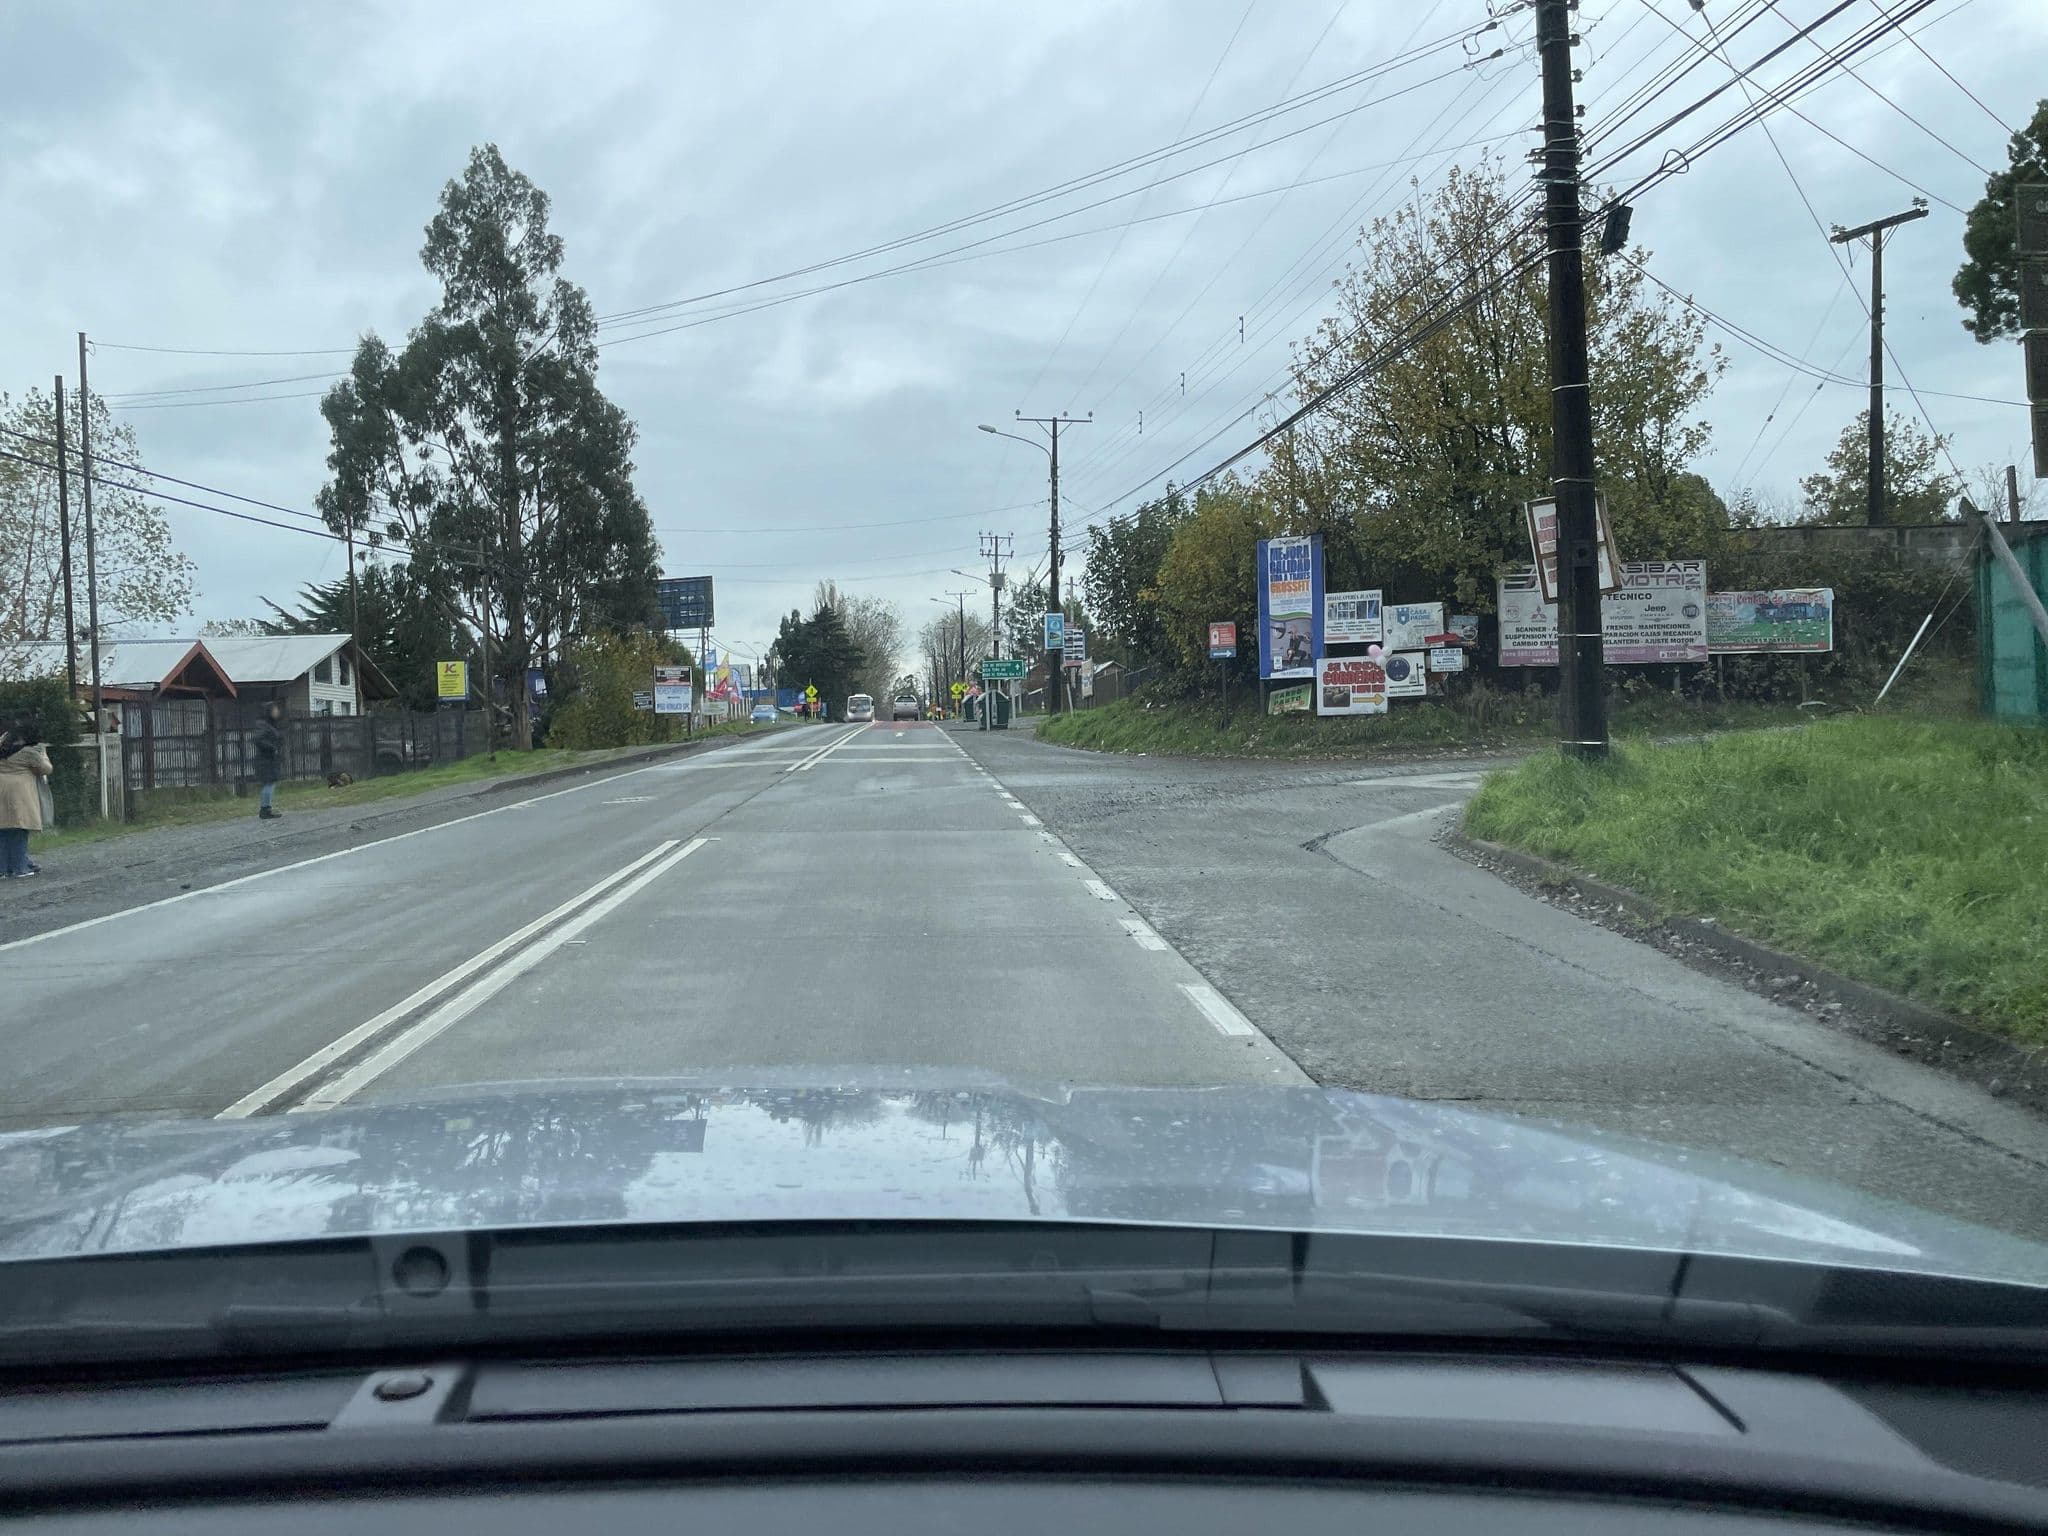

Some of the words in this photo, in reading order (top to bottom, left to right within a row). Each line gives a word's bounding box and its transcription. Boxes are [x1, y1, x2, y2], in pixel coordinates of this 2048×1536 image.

[1620, 573, 1701, 586] MOTRIZ
[1607, 592, 1652, 601] TECNICO
[1644, 604, 1667, 612] Jeep
[1323, 669, 1386, 685] CORDEROS
